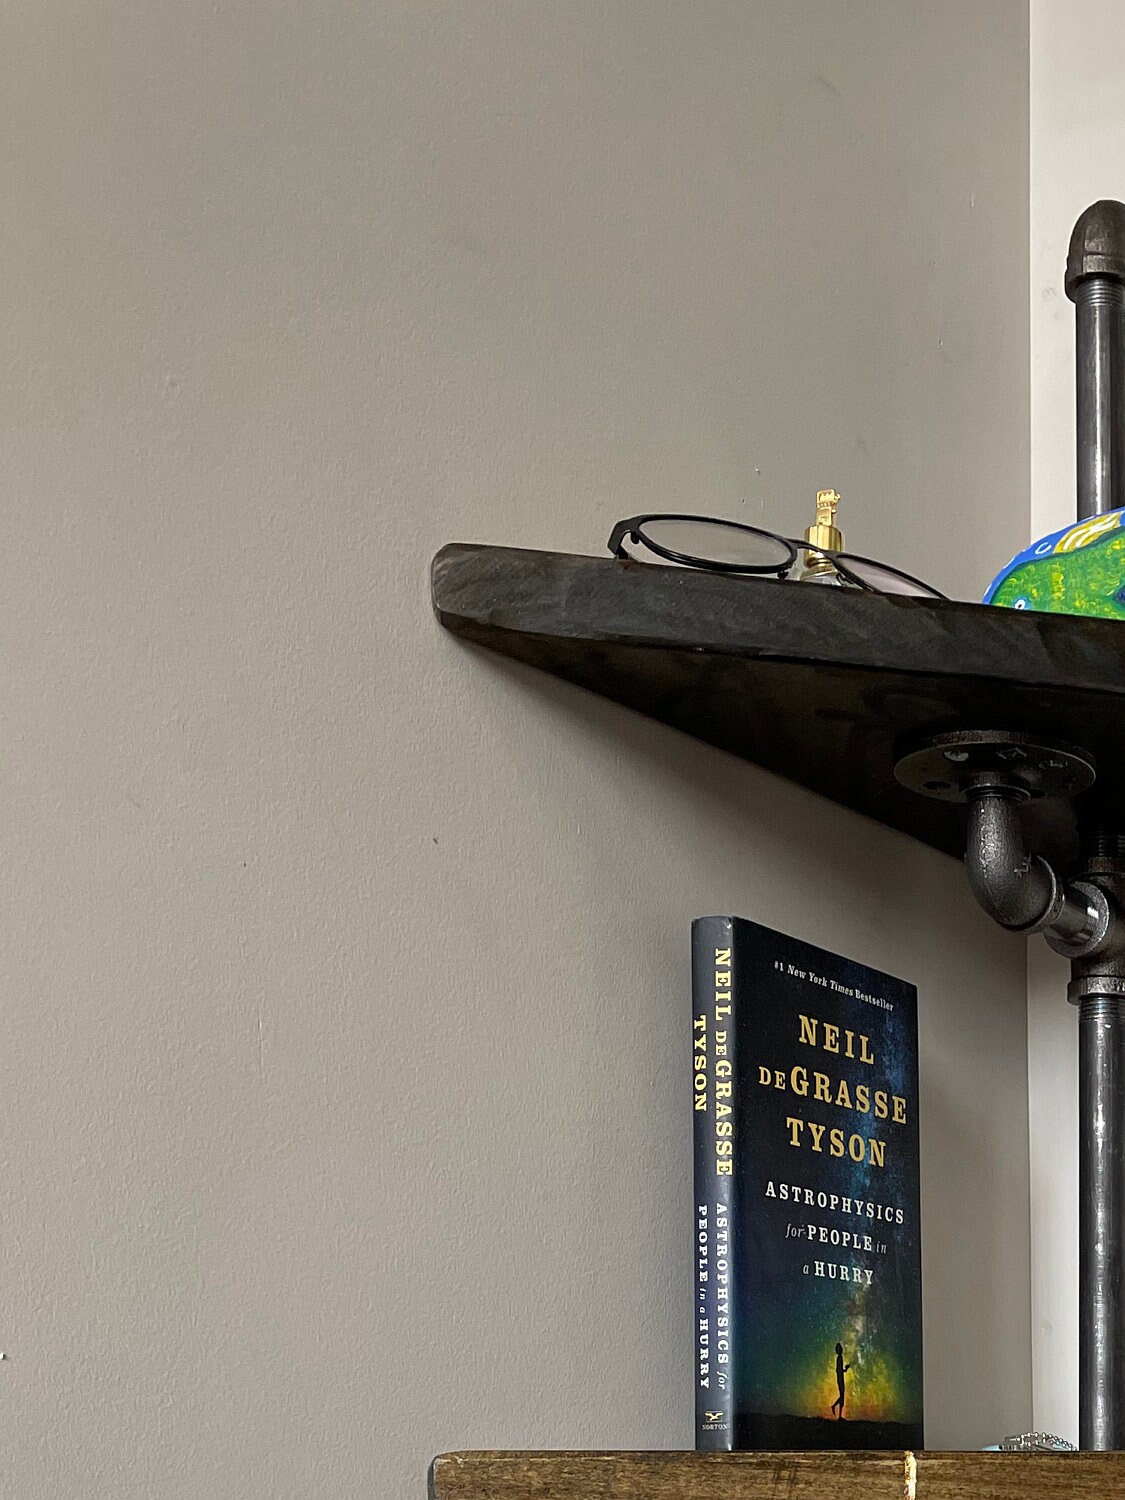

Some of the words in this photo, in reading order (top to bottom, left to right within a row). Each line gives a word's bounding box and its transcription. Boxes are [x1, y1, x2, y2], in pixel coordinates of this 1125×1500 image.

[715, 948, 731, 1021] NEIL
[774, 960, 784, 972] #1
[787, 964, 806, 979] New
[809, 972, 828, 987] York
[830, 979, 854, 997] Times
[855, 989, 894, 1012] Bestseller
[694, 1014, 707, 1112] TYSON
[798, 1014, 875, 1065] NEIL
[786, 1116, 887, 1168] TYSON
[765, 1180, 905, 1225] ASTROPHYSICS
[698, 1205, 709, 1283] PEOPLE
[785, 1223, 804, 1239] for
[807, 1224, 873, 1252] PEOPLE
[876, 1240, 888, 1255] in
[699, 1287, 706, 1300] in
[716, 1203, 730, 1365] ASTROPHYSICS
[803, 1264, 810, 1276] a
[814, 1260, 874, 1286] HURRY
[699, 1306, 706, 1314] a
[699, 1318, 710, 1389] HURRY
[717, 1371, 730, 1390] for
